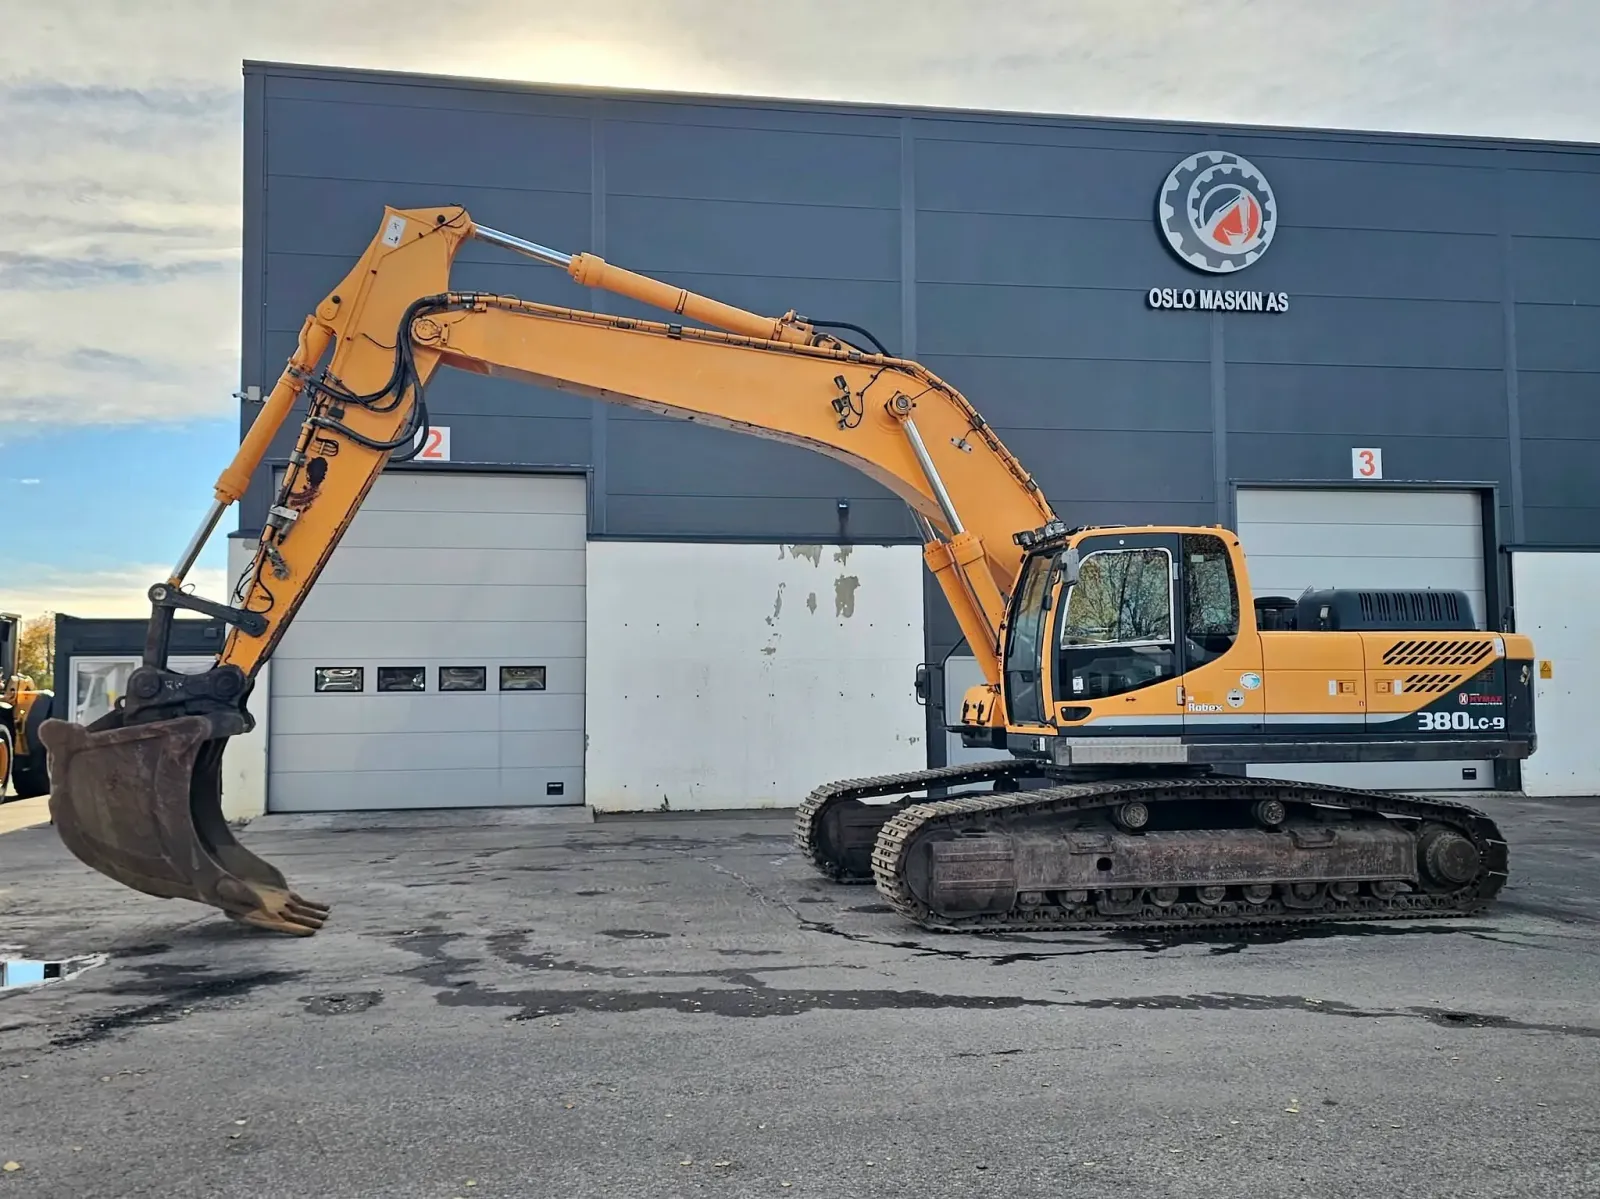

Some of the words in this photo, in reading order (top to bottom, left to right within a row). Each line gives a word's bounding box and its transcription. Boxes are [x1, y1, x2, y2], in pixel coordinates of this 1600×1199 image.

[1149, 287, 1196, 309] OSLO
[1199, 289, 1263, 311] MASKIN
[1266, 291, 1289, 312] AS
[422, 429, 442, 457] 2
[1359, 451, 1375, 476] 3
[1188, 703, 1223, 712] Robex
[1417, 712, 1505, 730] 380LC-9
